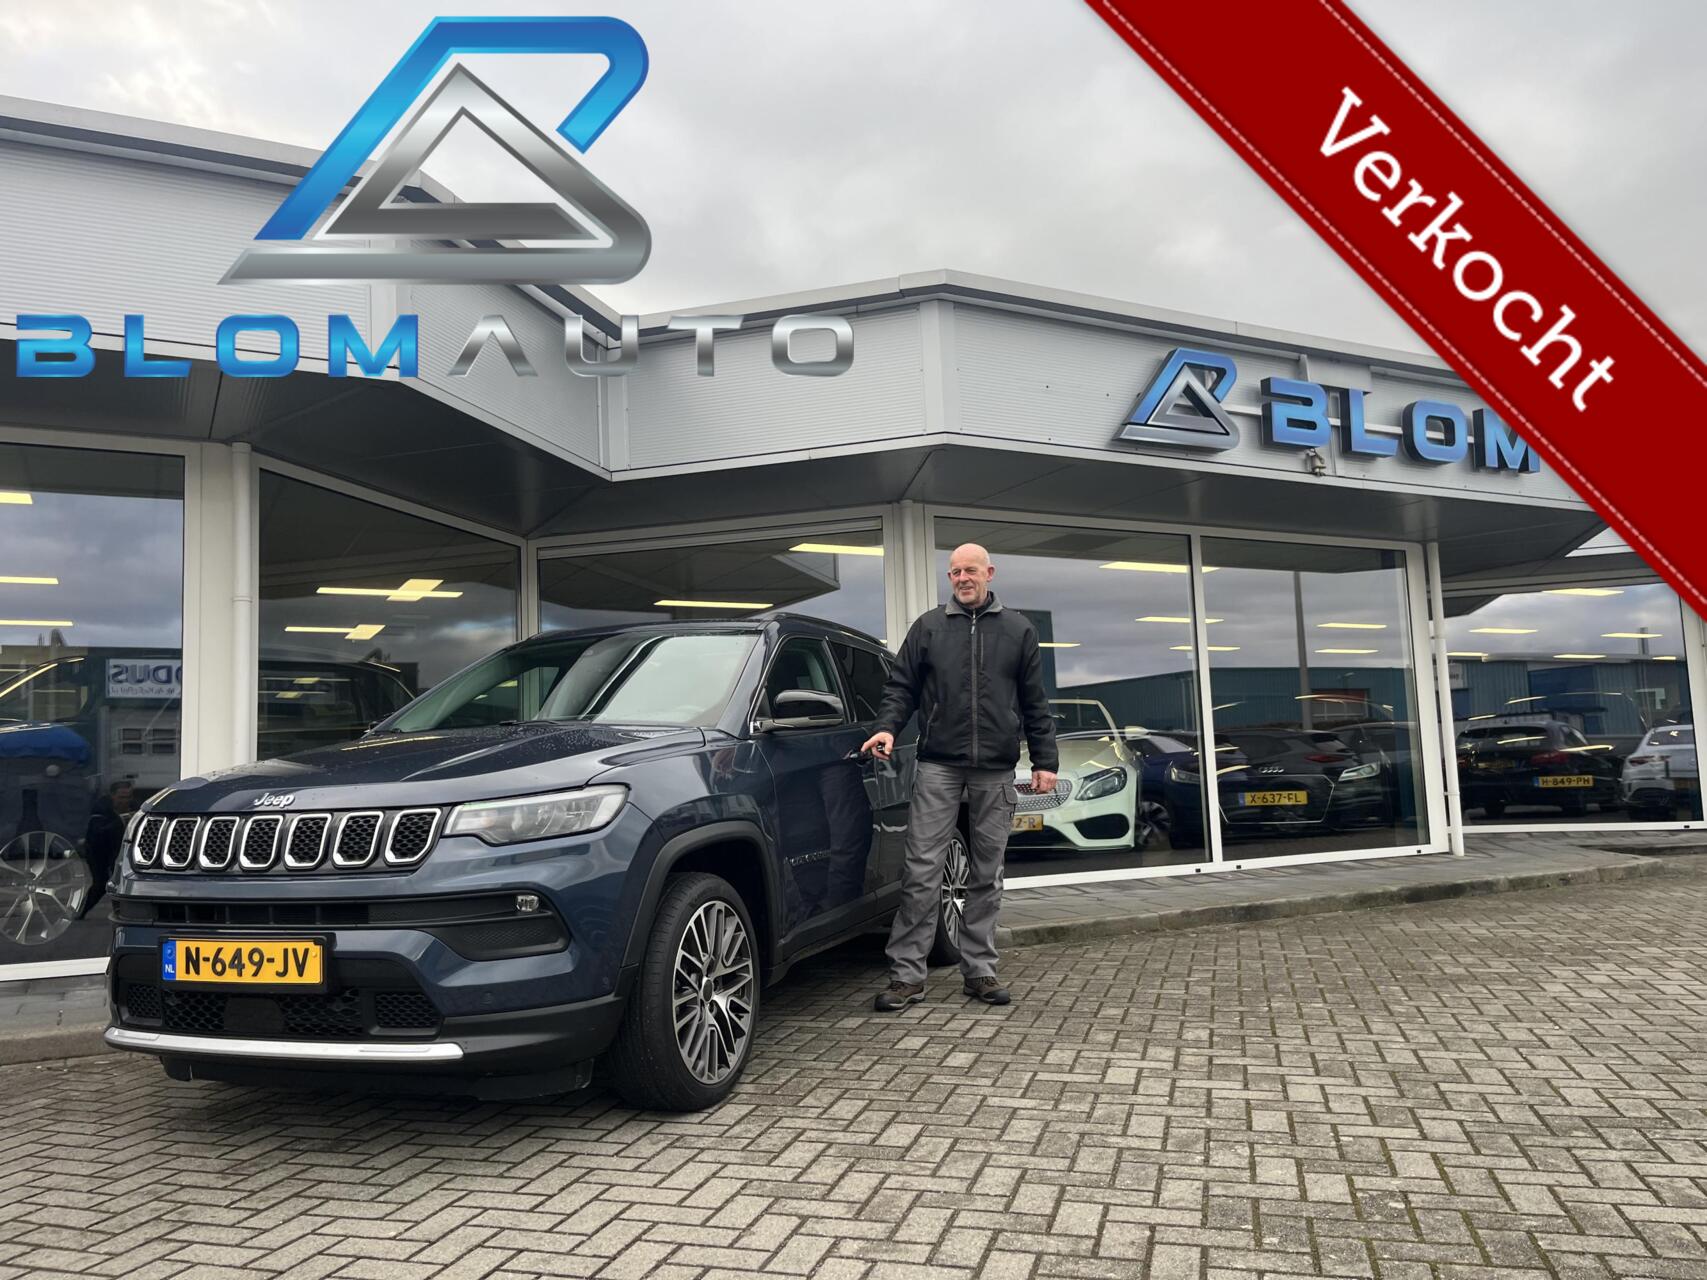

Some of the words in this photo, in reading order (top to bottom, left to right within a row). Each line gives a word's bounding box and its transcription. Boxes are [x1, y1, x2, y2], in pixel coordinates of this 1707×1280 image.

[1260, 376, 1541, 474] BLOM
[253, 792, 295, 808] Jeep
[1249, 792, 1302, 804] X-637-FL
[164, 963, 175, 973] NL
[184, 946, 310, 978] N-649-JV
